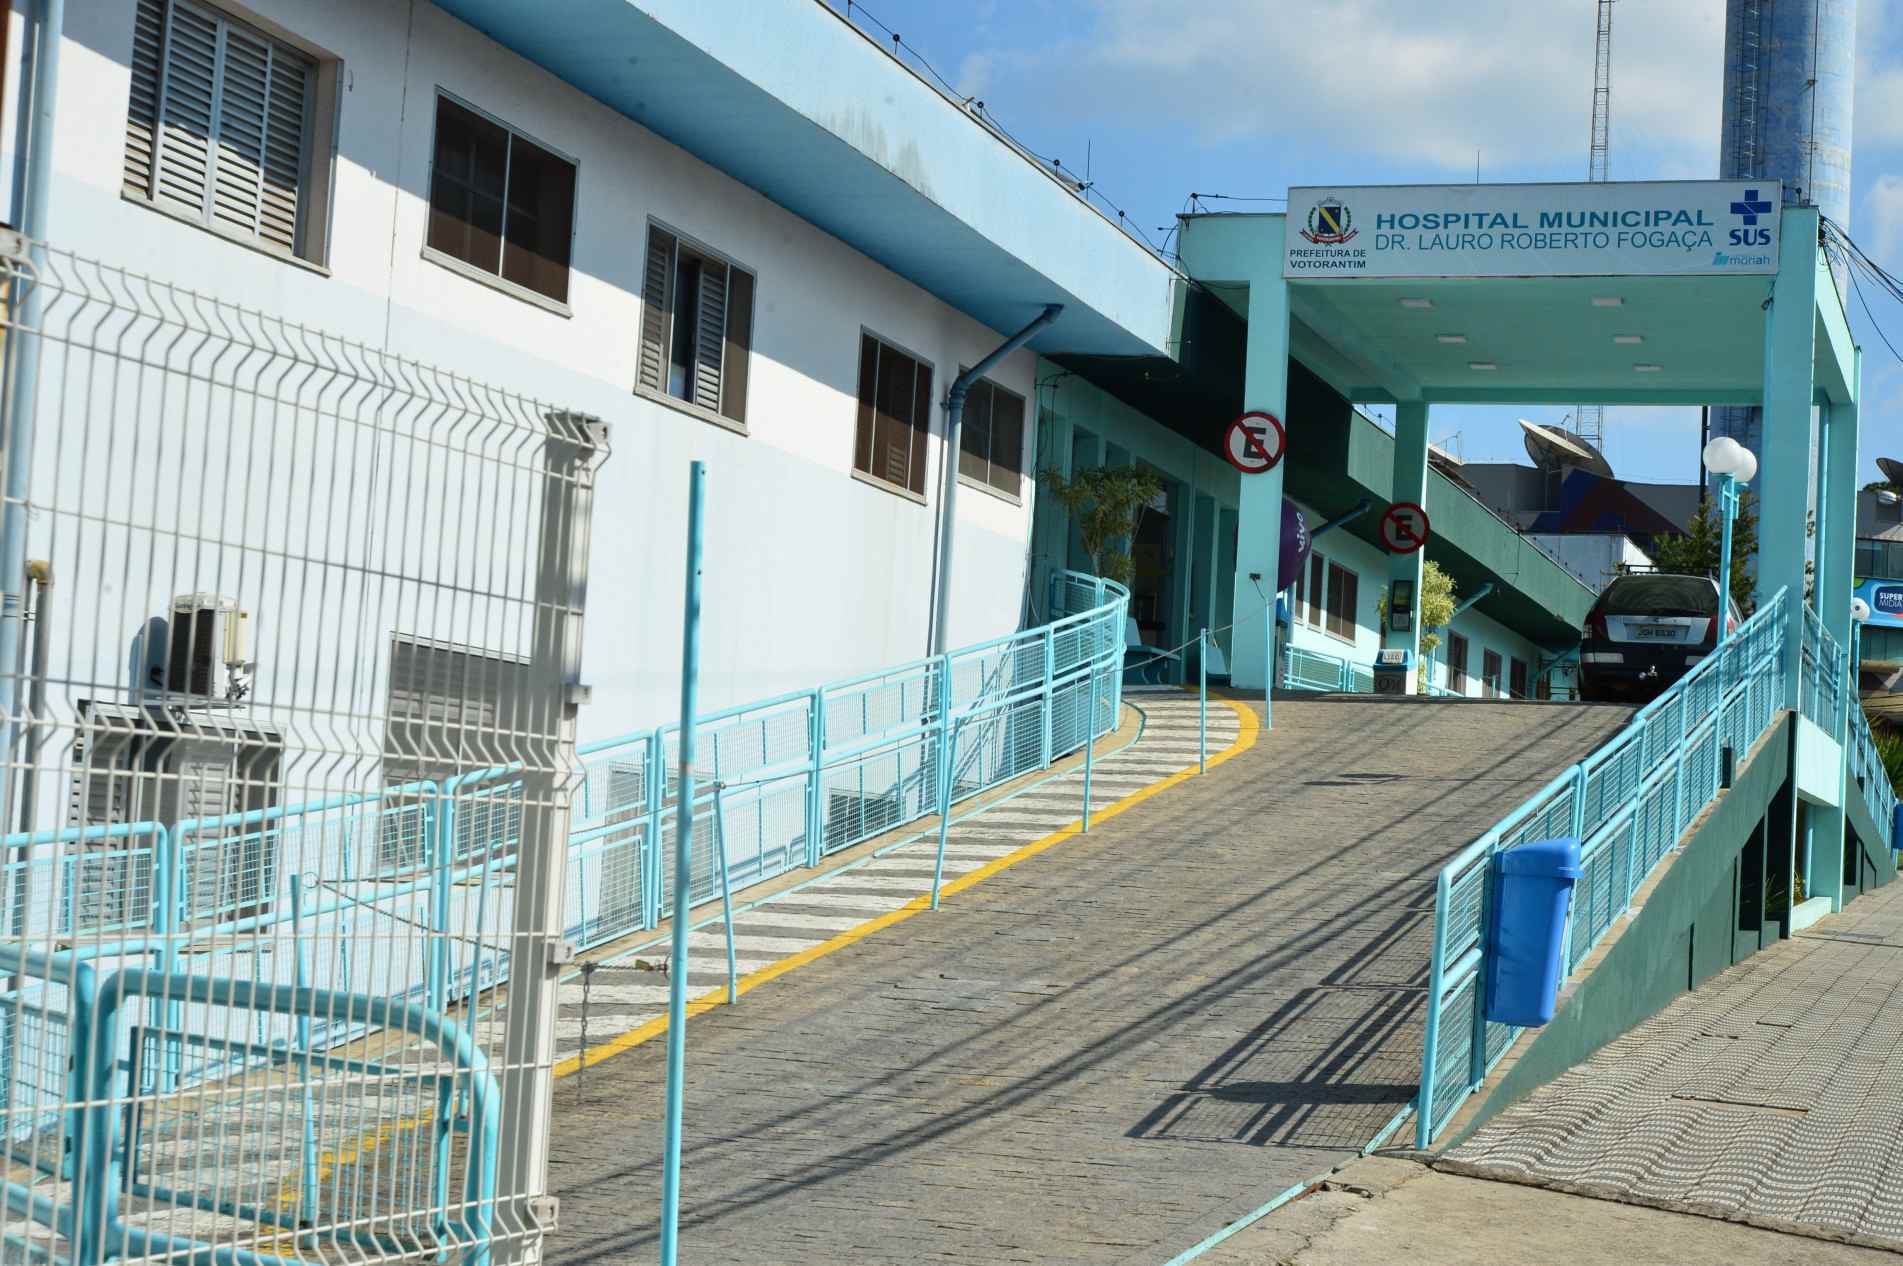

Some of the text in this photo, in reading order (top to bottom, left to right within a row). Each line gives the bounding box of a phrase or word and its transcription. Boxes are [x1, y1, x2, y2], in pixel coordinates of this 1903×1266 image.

[1376, 209, 1714, 230] HOSPITAL MUNICIPAL
[1376, 230, 1713, 251] DR. LAURO ROBERTO FOGAÇA
[1729, 229, 1771, 246] SUS
[1289, 249, 1366, 258] PREFEITURA DE
[1289, 260, 1366, 269] VOTORANTIM
[1243, 427, 1267, 459] E
[1296, 512, 1306, 553] vivo
[1396, 515, 1412, 540] E
